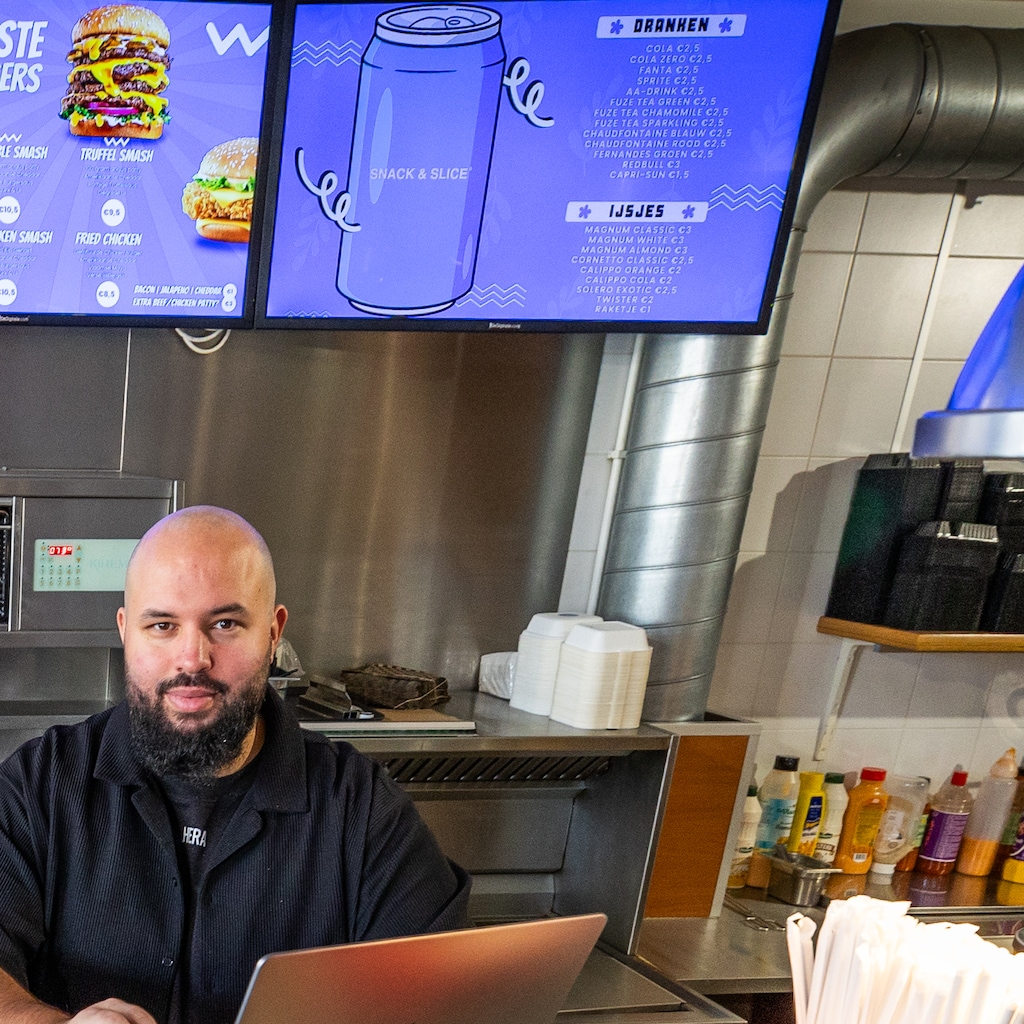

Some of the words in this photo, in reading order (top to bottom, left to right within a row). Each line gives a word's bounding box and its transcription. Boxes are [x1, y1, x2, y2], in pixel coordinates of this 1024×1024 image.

[634, 18, 709, 33] DRANKEN
[646, 45, 673, 53] COLA
[677, 44, 700, 53] €2,5
[660, 55, 686, 63] ZERO
[689, 55, 712, 63] €2,5
[639, 66, 672, 74] FANTA
[676, 66, 698, 74] €2,5
[637, 77, 671, 85] SPRITE
[674, 77, 697, 85] €2,5
[681, 87, 703, 95] €2,5
[658, 98, 690, 106] GREEN
[694, 98, 716, 106] €2,5
[594, 109, 617, 117] FUZE
[641, 109, 702, 117] CHAMOMILE
[706, 108, 728, 116] €2,5
[643, 119, 698, 127] SPARKLING
[701, 119, 724, 127] €2,5
[583, 130, 668, 138] CHAUDFONTAINE
[671, 130, 706, 138] BLAUW
[709, 129, 732, 138] €2,5
[585, 140, 669, 148] CHAUDFONTAINE
[672, 140, 701, 148] ROOD
[704, 140, 727, 148] €2,5
[13, 146, 48, 159] SMASH
[80, 148, 116, 161] TRUFFEL
[120, 150, 154, 163] SMASH
[691, 150, 713, 158] €2,5
[370, 168, 415, 179] SNACK
[418, 169, 427, 179] &
[610, 171, 665, 179] CAPRI-SUN
[668, 171, 689, 179] €1,5
[0, 206, 18, 214] €10,5
[609, 205, 664, 217] IJSJES
[585, 226, 630, 234] MAGNUM
[19, 231, 53, 244] SMASH
[76, 232, 101, 245] FRIED
[103, 233, 142, 246] CHICKEN
[588, 236, 633, 244] MAGNUM
[637, 236, 668, 244] WHITE
[671, 236, 684, 244] €3
[581, 246, 626, 254] MAGNUM
[629, 246, 671, 254] ALMOND
[675, 246, 688, 254] €3
[571, 256, 623, 264] CORNETTO
[626, 256, 668, 264] CLASSIC
[672, 256, 694, 264] €2,5
[625, 266, 665, 274] ORANGE
[668, 266, 681, 274] €2
[585, 276, 626, 284] CALIPPO
[629, 276, 656, 284] COLA
[659, 276, 672, 284] €2
[134, 285, 155, 294] BACON
[655, 286, 677, 294] €2,5
[133, 298, 151, 306] EXTRA
[182, 826, 207, 847] HERA
